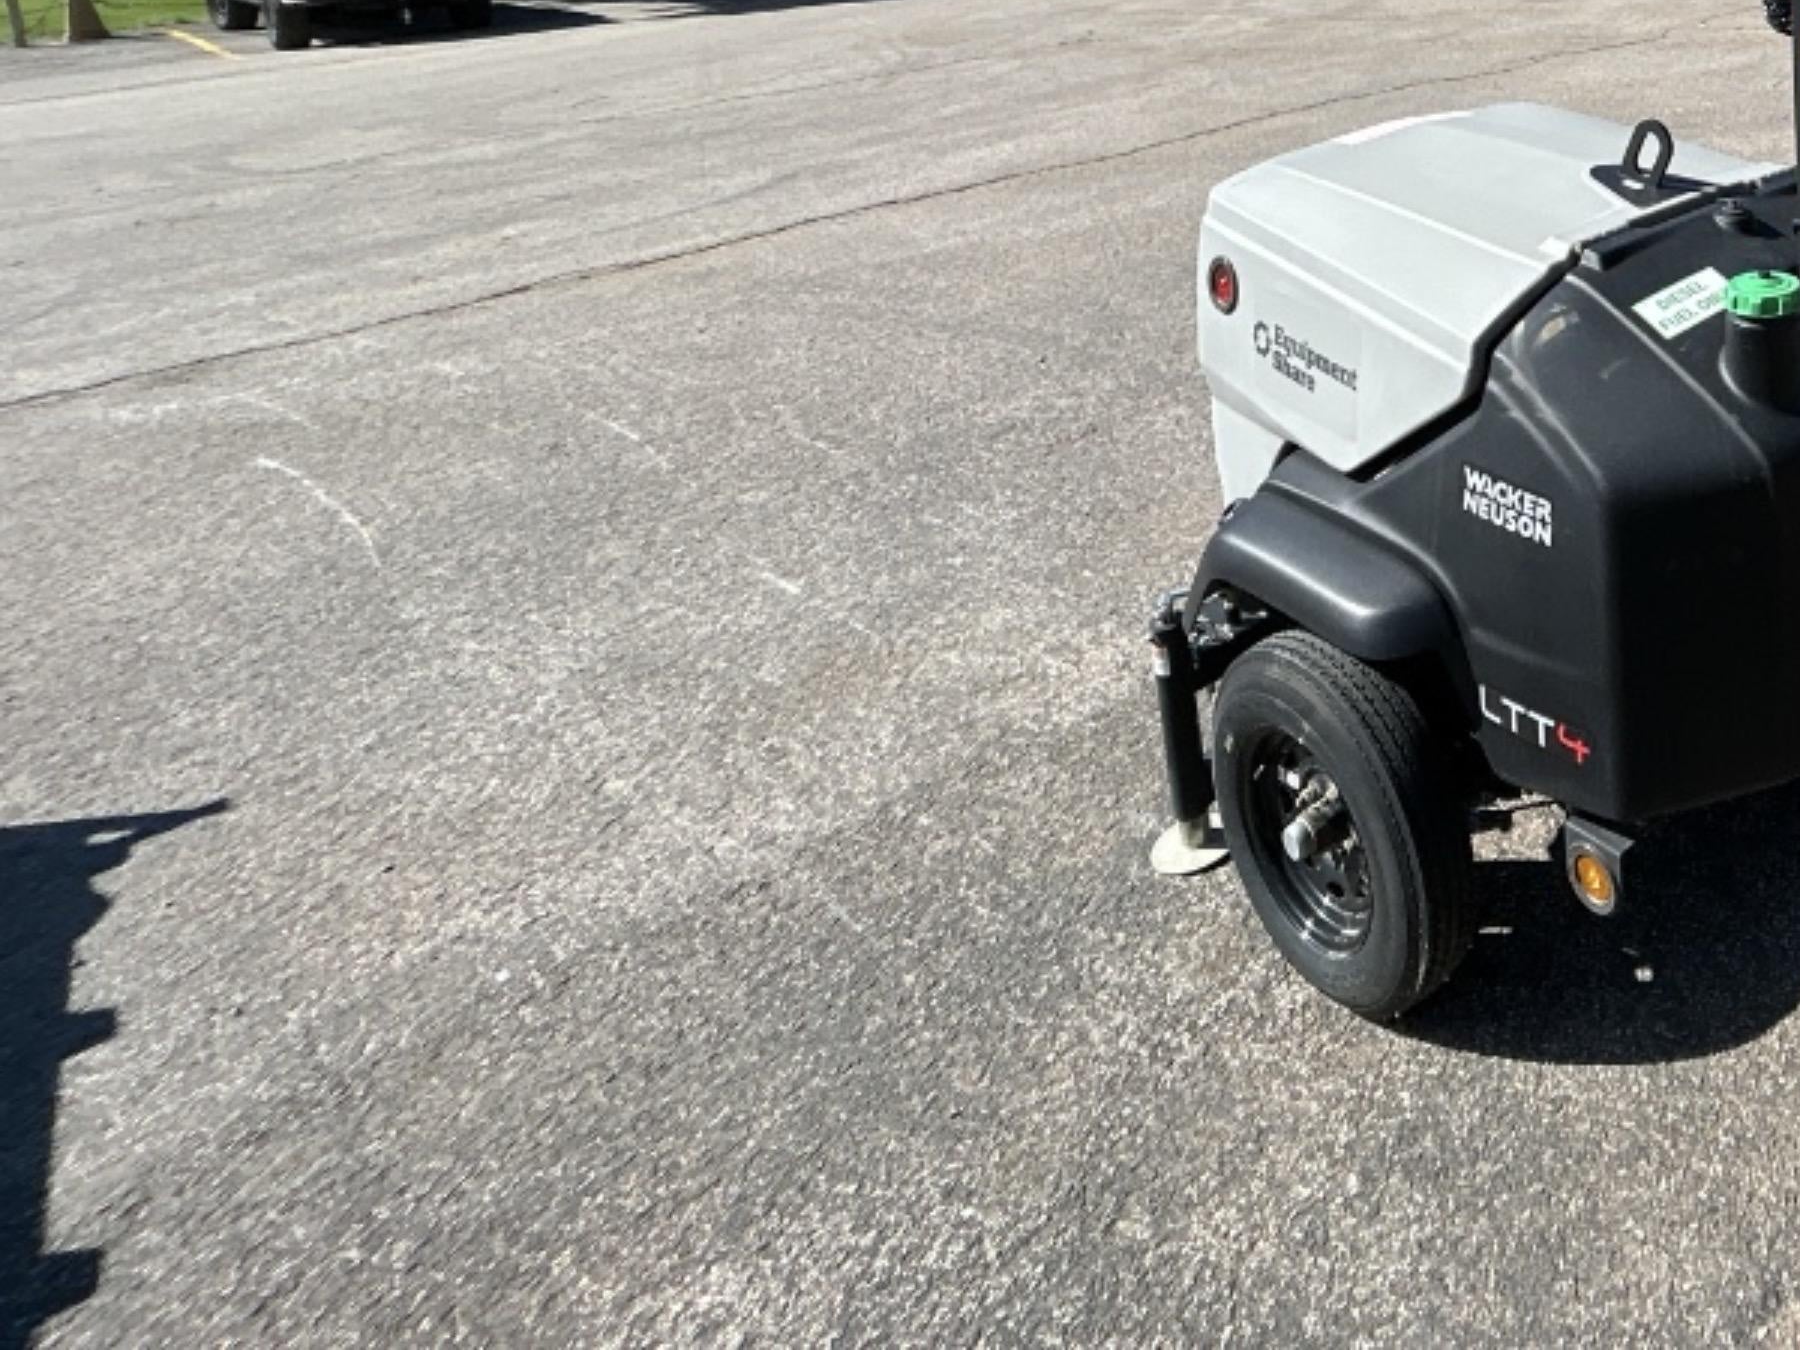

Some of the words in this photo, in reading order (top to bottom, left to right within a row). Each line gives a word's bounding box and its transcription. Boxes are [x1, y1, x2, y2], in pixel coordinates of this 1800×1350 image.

[1274, 323, 1357, 391] Equipment
[1463, 464, 1552, 523] WACKER
[1463, 489, 1552, 547] NEUSON
[1478, 683, 1591, 764] LTT4
